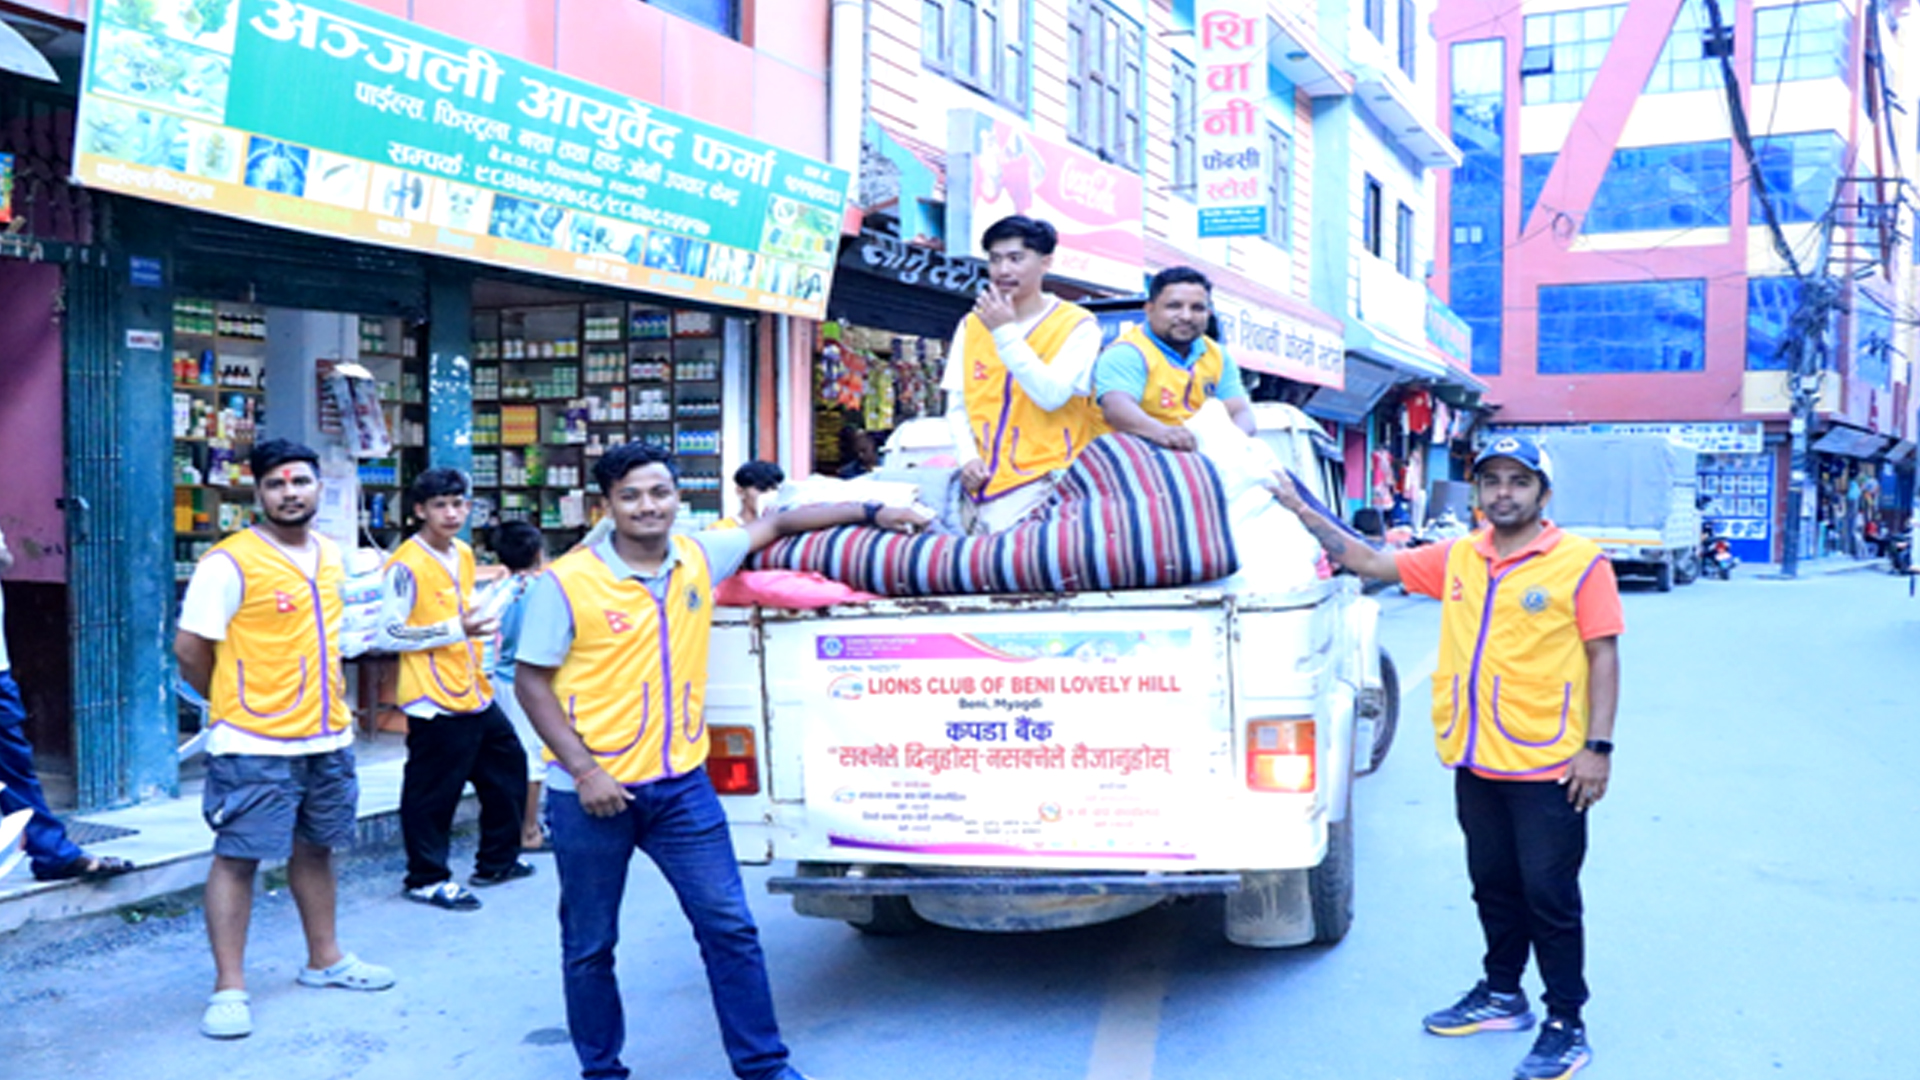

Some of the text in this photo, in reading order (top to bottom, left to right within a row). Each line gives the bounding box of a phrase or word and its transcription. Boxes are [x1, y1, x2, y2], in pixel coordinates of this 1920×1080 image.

[517, 76, 683, 160] आयुर्वेद
[692, 133, 779, 188] फर्मा
[868, 675, 1181, 695] LIONS CLUB OF BENI LOVELY HILL
[958, 698, 1043, 712] Beni, Myagdi
[946, 715, 1054, 742] कपडा बैंक
